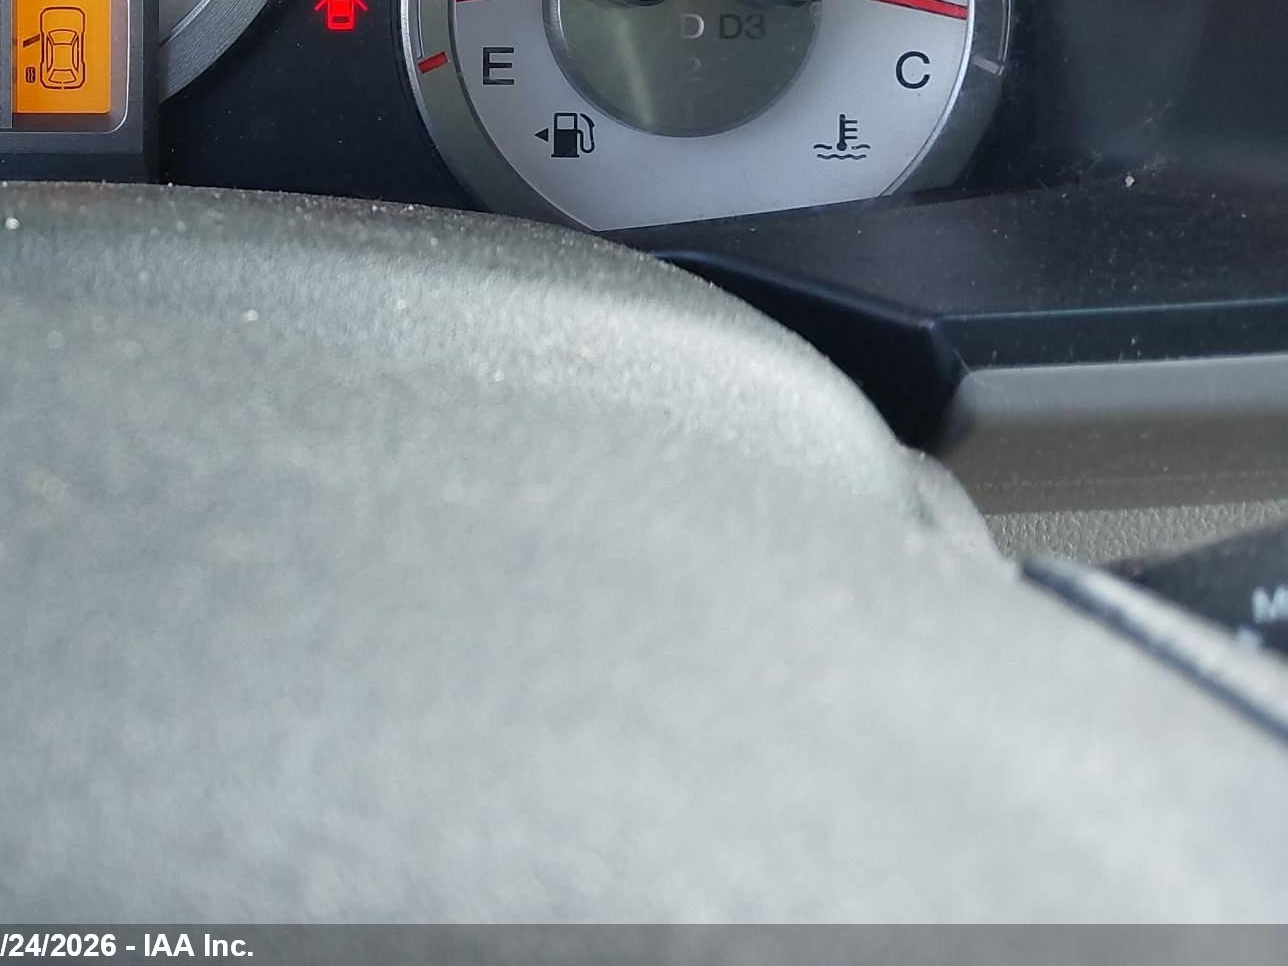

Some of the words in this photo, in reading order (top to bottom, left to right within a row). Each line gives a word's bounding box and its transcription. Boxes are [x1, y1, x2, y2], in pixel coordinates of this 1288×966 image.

[680, 12, 705, 40] D
[718, 13, 766, 40] D3
[483, 46, 514, 85] E
[896, 51, 930, 89] C
